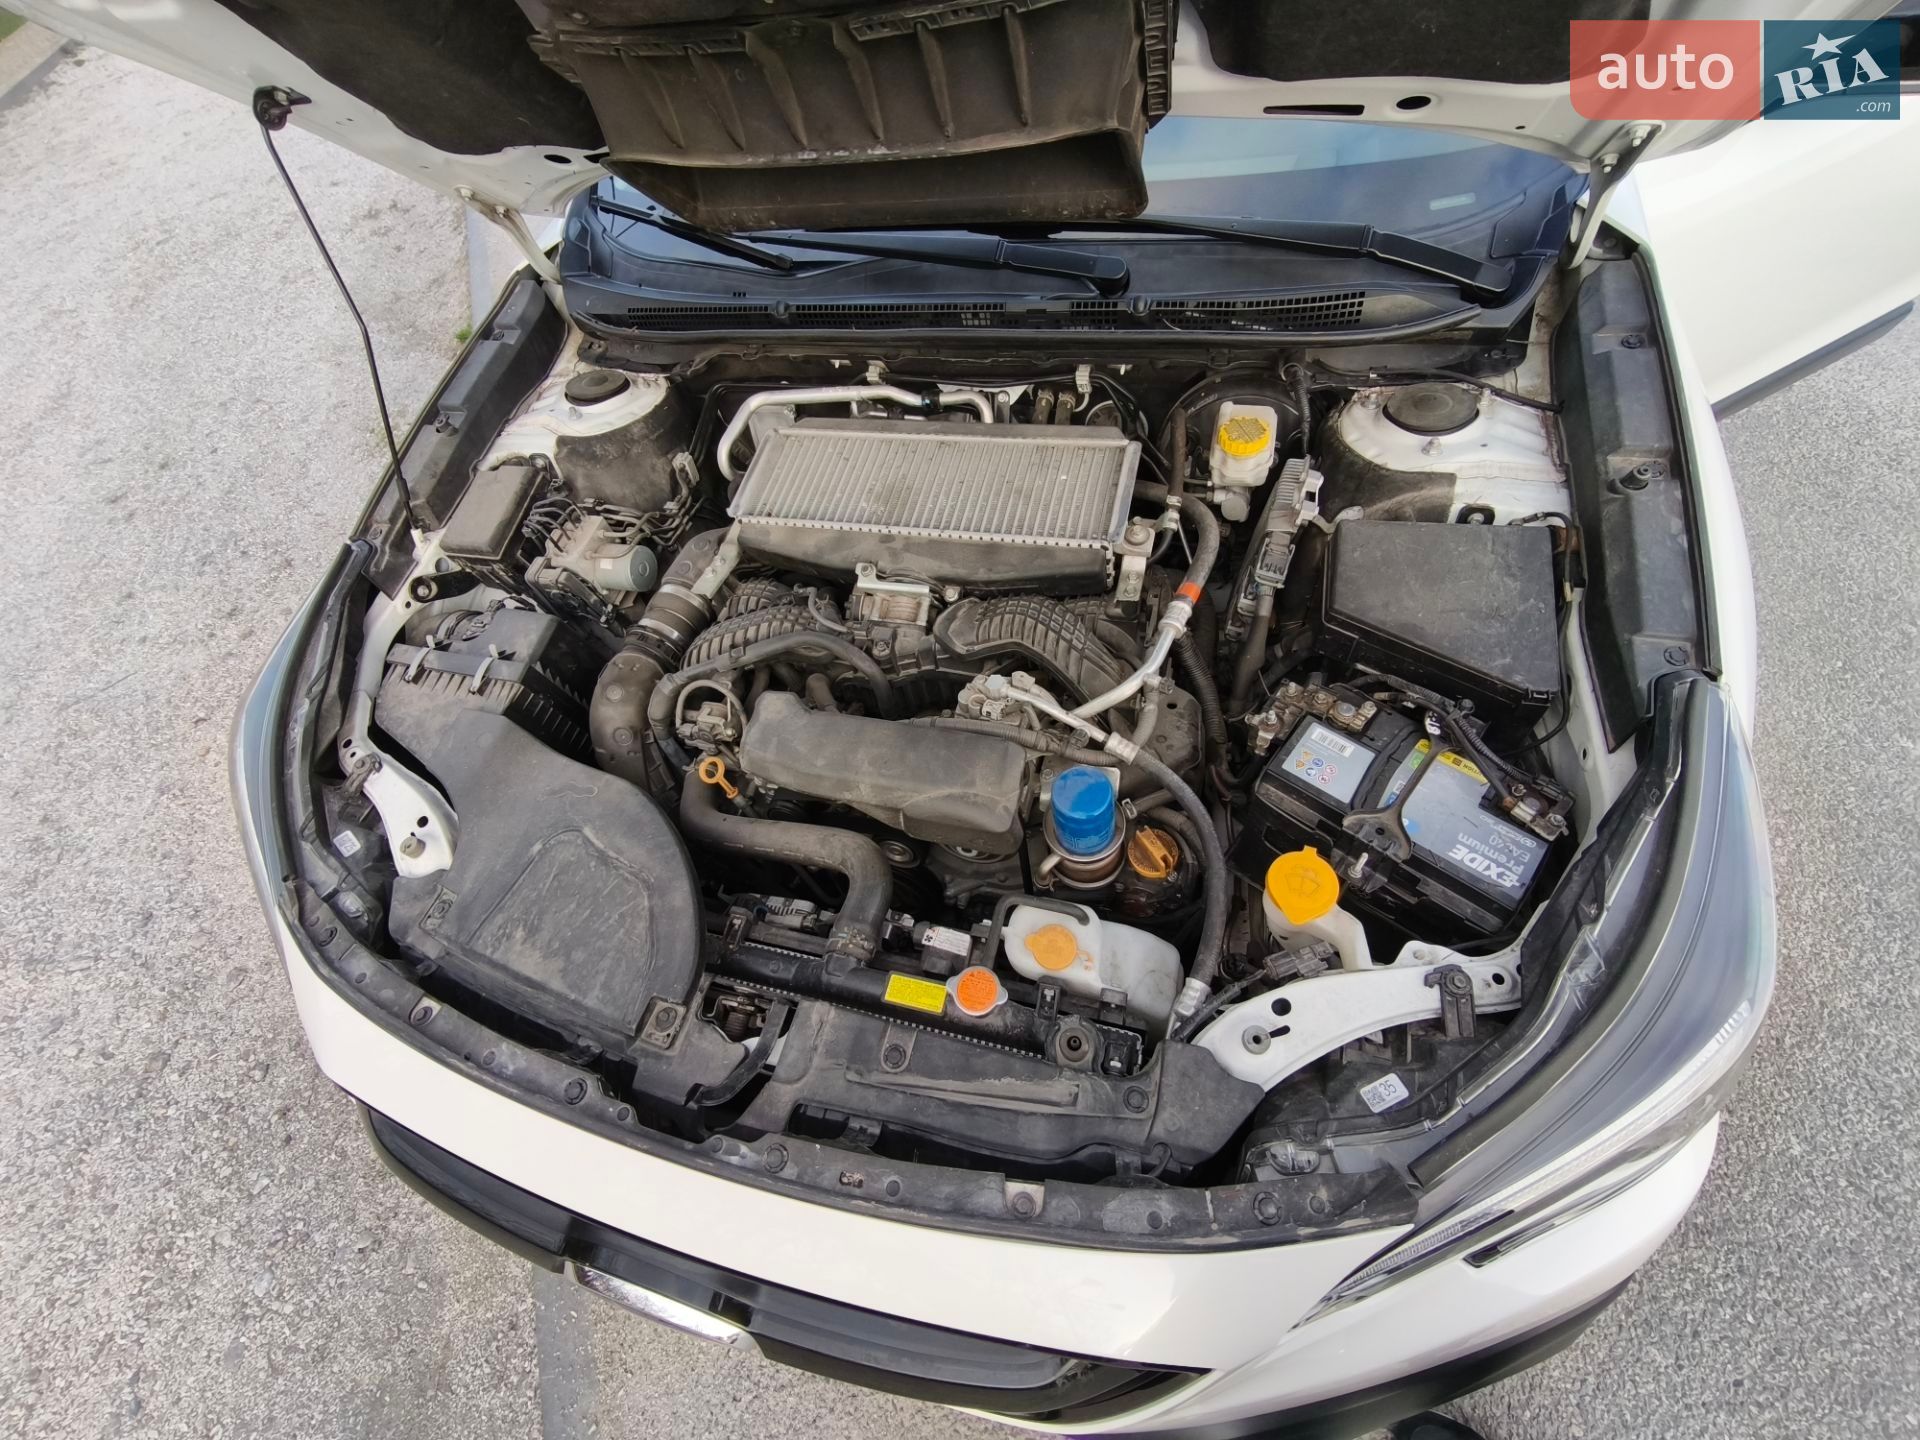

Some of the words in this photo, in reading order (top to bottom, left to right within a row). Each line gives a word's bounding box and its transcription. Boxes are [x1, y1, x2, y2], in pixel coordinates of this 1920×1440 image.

[1448, 844, 1520, 888] EXIDE
[1457, 832, 1524, 875] Premium
[1378, 1079, 1397, 1097] 35
